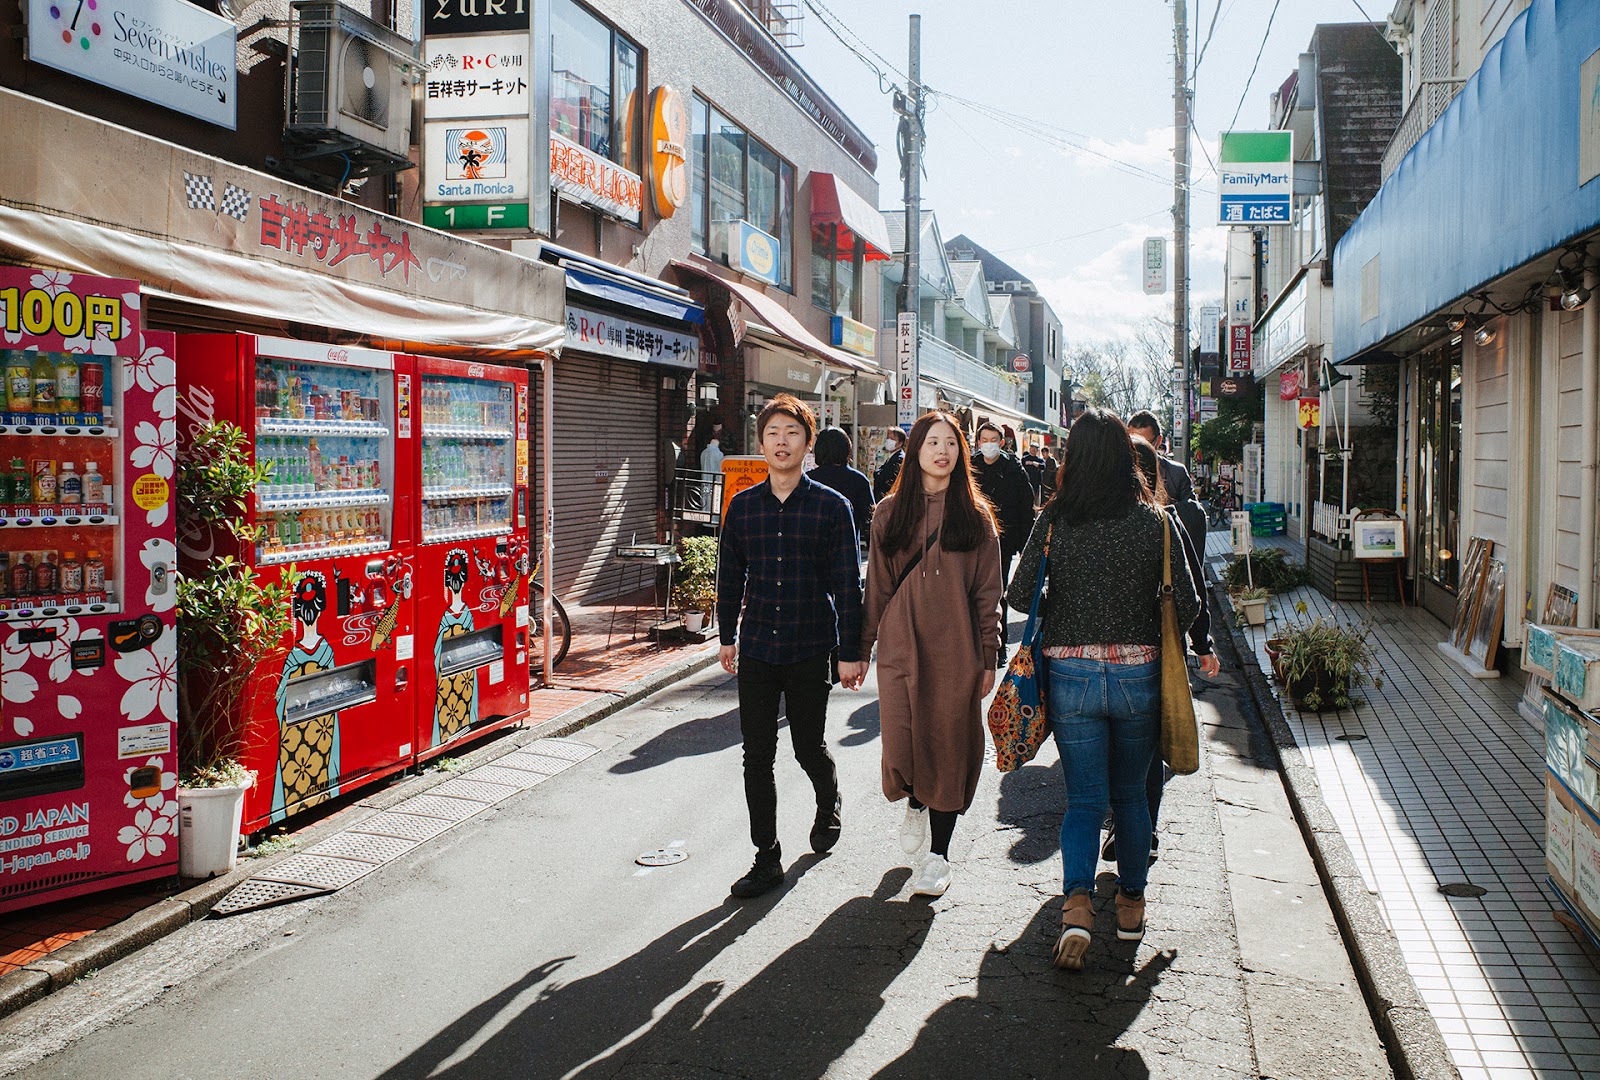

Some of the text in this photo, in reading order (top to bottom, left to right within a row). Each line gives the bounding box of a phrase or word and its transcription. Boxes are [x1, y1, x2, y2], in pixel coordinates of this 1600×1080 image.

[113, 10, 171, 61] Seven
[113, 48, 214, 96] 中央入口から2階へどうぞ
[427, 77, 527, 99] 吉祥寺サーキット
[438, 182, 514, 196] Santa Monica
[599, 164, 643, 212] LION
[1222, 172, 1289, 187] FamilyMart
[1226, 204, 1284, 221] 酒 たばこ
[258, 192, 424, 288] 吉祥寺サーキット
[0, 286, 121, 342] 100円
[1235, 299, 1248, 311] if
[625, 326, 696, 363] 吉祥寺サーキット
[1233, 359, 1248, 369] 2F
[20, 743, 72, 762] 超省エネ
[21, 802, 89, 832] JAPAN
[44, 824, 89, 844] SERVICE
